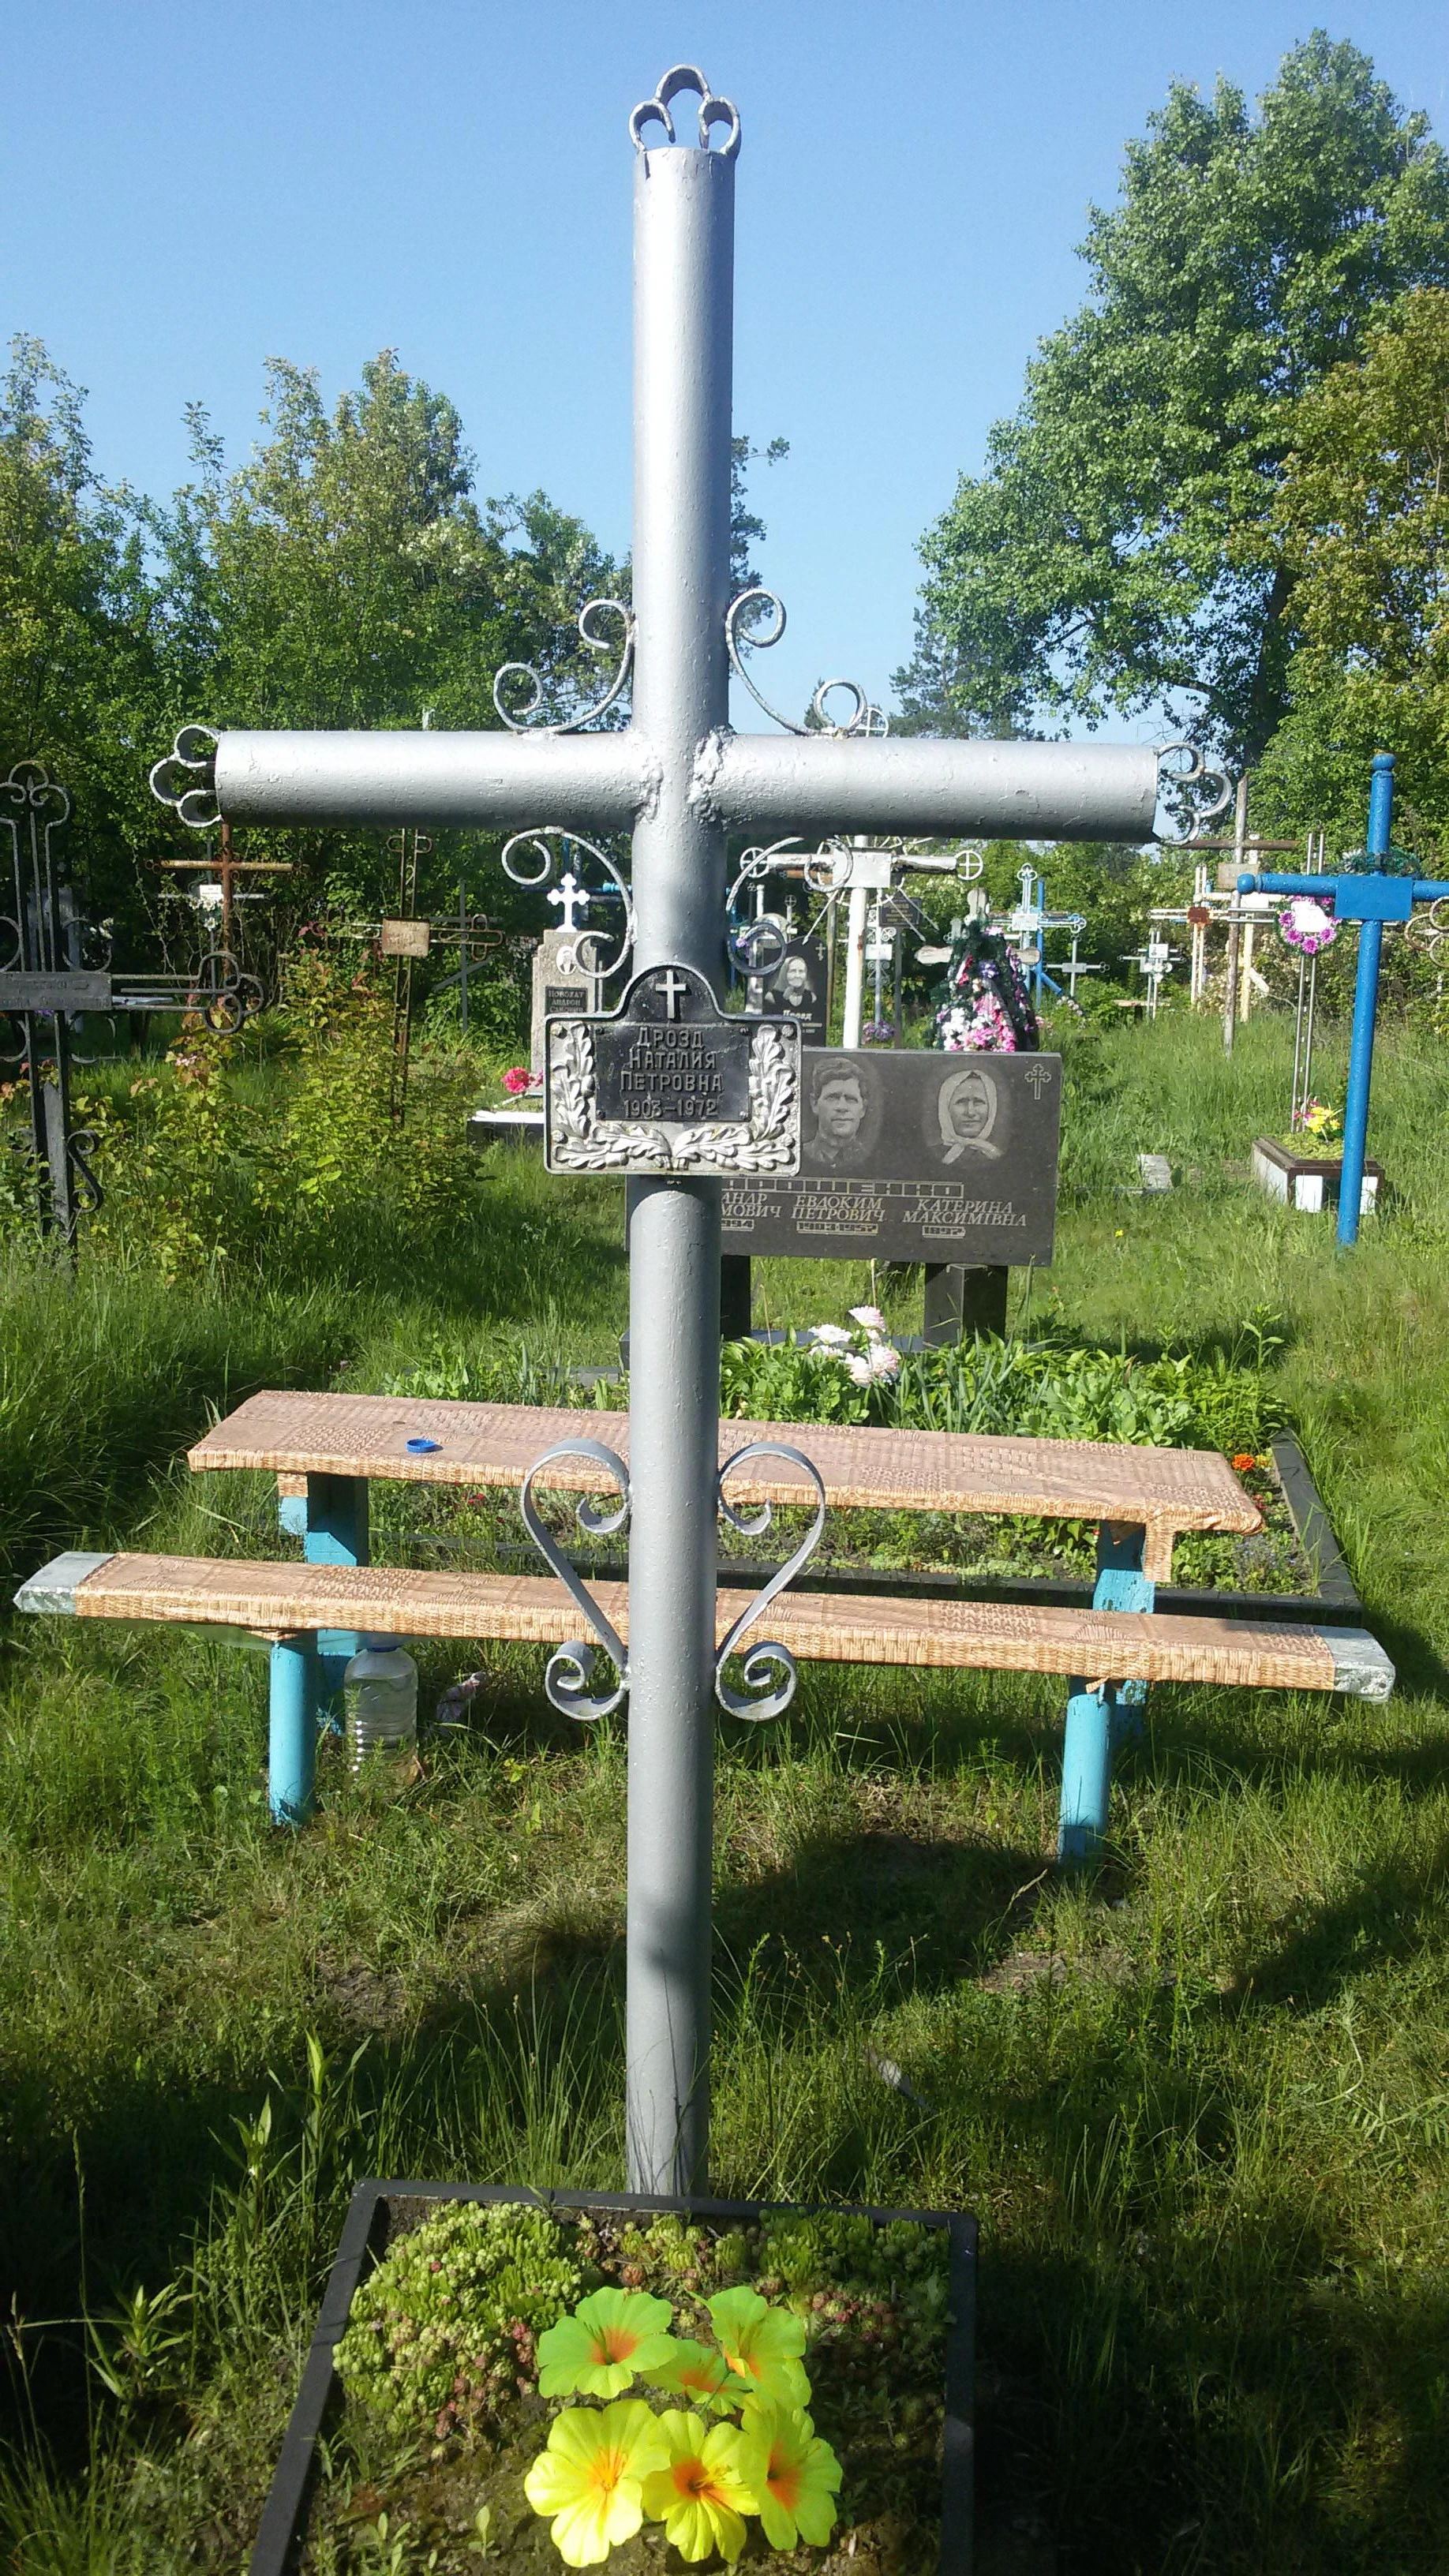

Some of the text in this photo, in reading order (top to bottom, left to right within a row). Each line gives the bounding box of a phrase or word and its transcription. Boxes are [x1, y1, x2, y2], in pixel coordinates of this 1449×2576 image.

[637, 1027, 704, 1048] ДРОЗД
[629, 1047, 717, 1069] НАТАЛИЯ
[620, 1070, 723, 1091] ПЕТРОВНА
[795, 1195, 883, 1210] ЕВДОКИМ
[916, 1199, 1013, 1214] КАТЕРИНА
[790, 1207, 886, 1222] ПЕТРОВИЧ
[902, 1211, 1027, 1226] МАКСИМІВНА
